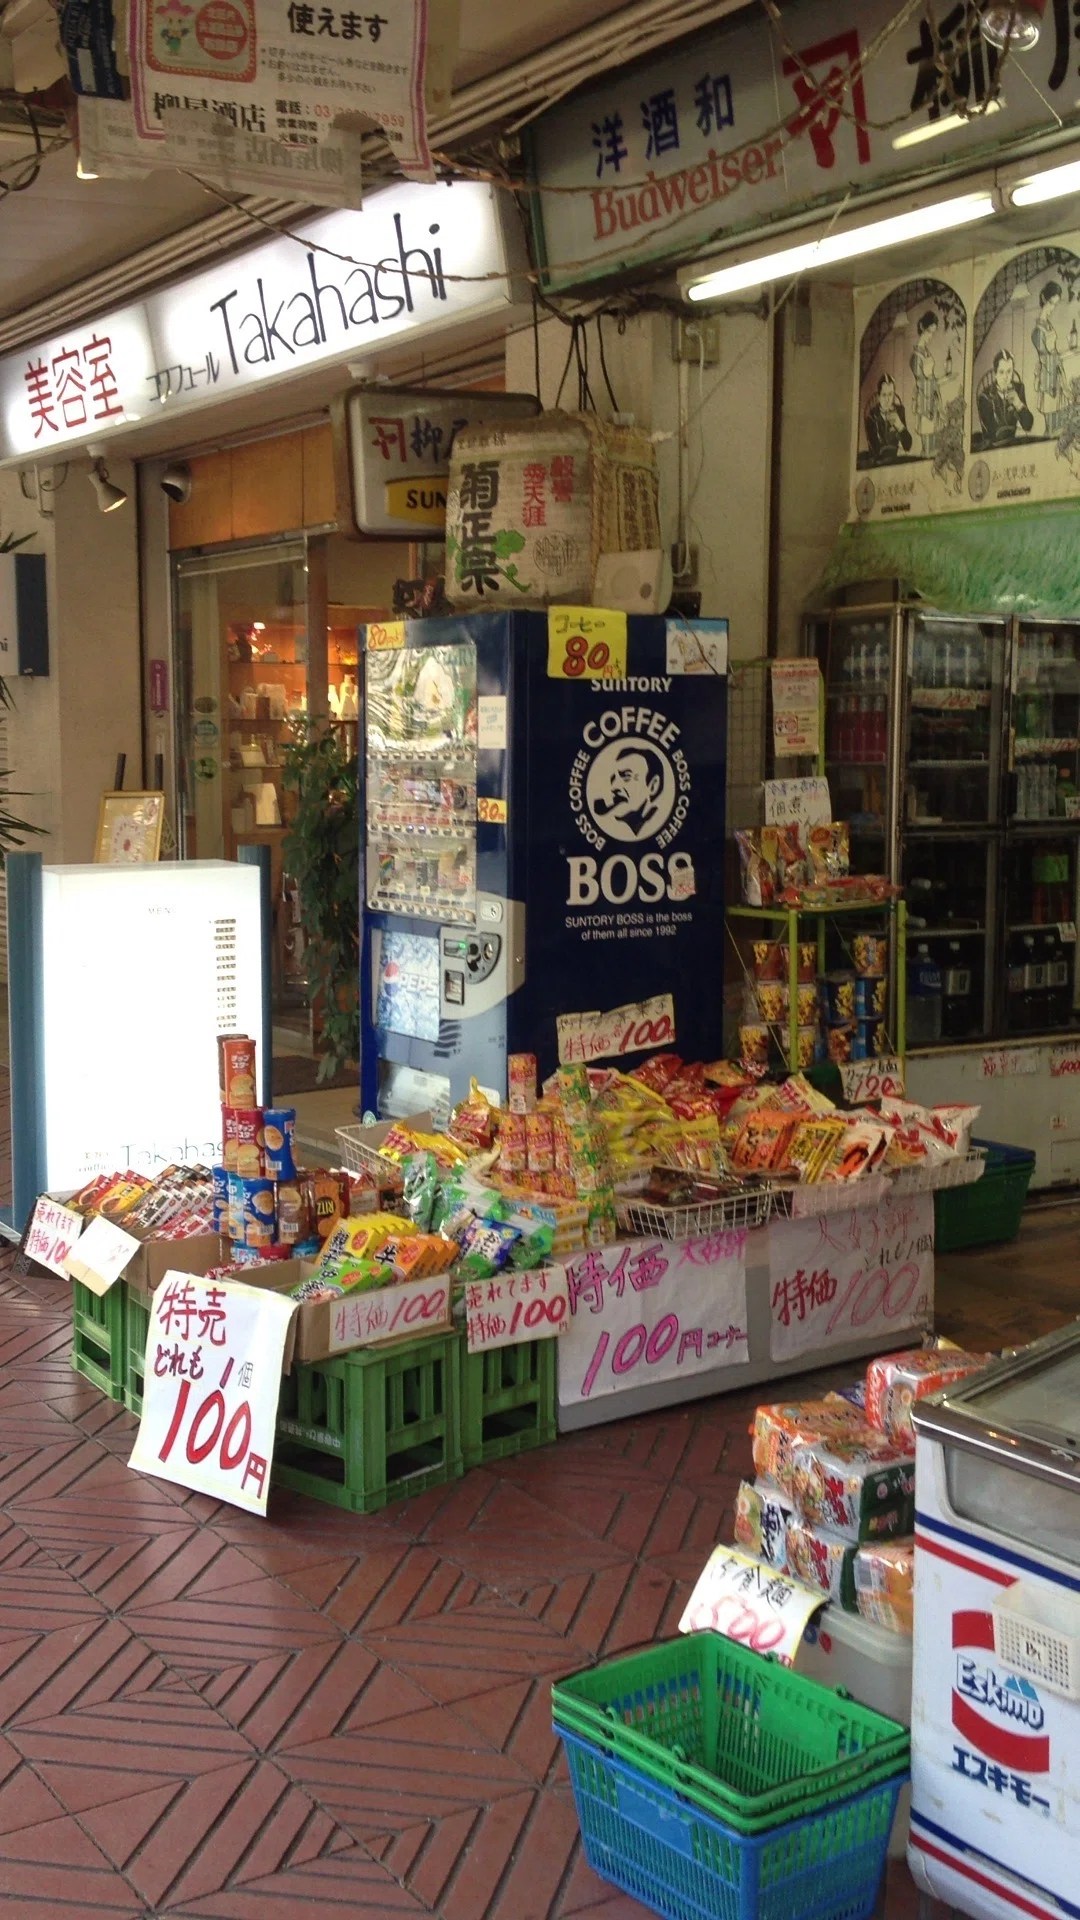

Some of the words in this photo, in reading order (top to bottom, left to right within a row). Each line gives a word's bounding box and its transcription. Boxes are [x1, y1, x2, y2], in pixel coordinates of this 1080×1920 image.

[288, 2, 388, 42] 使えます
[592, 138, 784, 243] Budweiser
[210, 213, 447, 375] Takahashi
[24, 333, 124, 439] 美容室
[460, 460, 500, 595] 菊正宗
[562, 636, 610, 677] 80
[582, 706, 682, 750] COFFEE
[568, 749, 591, 812] COFFEE
[671, 749, 691, 792] BOSS
[575, 813, 606, 852] BOSS
[655, 795, 690, 850] COFFEE
[566, 852, 692, 906] BOSS
[565, 914, 615, 928] SUNTORY
[616, 913, 644, 925] BOSS
[646, 913, 654, 923] is
[655, 912, 669, 923] the
[671, 912, 692, 922] boss
[581, 930, 591, 941] of
[592, 929, 615, 940] them
[617, 928, 628, 939] all
[629, 927, 653, 938] since
[656, 926, 677, 936] 1992
[36, 1202, 75, 1232] 売れてます
[28, 1227, 49, 1255] 特価
[466, 1271, 550, 1310] 売れてます
[566, 1243, 668, 1316] 特価
[772, 1268, 838, 1327] 特価
[157, 1280, 227, 1346] 特売
[336, 1302, 388, 1341] 特価
[468, 1312, 506, 1345] 特価
[153, 1344, 204, 1380] どれも
[956, 1652, 1045, 1731] Eskimo
[952, 1744, 1050, 1809] エスキモー
